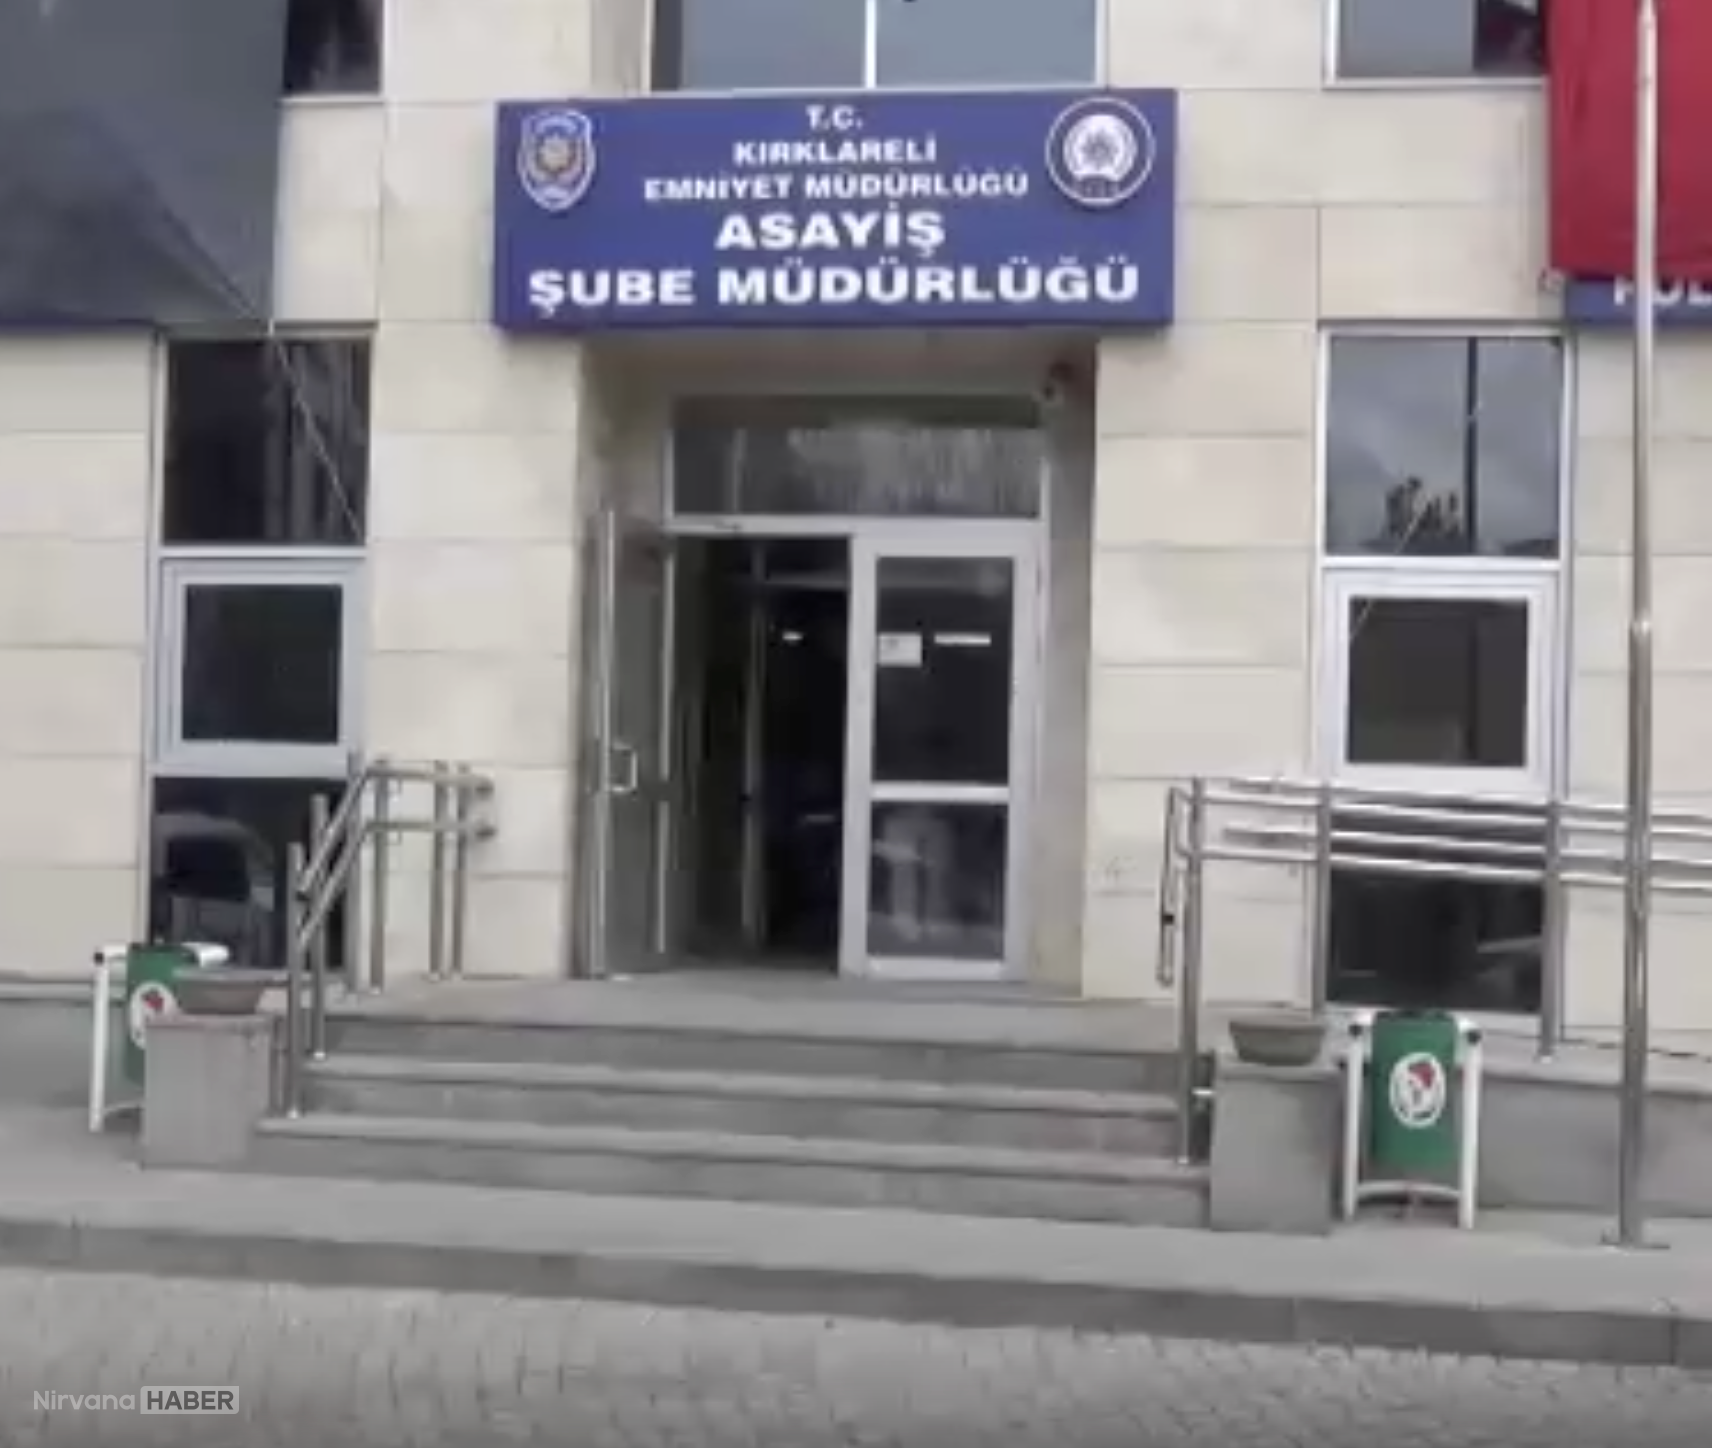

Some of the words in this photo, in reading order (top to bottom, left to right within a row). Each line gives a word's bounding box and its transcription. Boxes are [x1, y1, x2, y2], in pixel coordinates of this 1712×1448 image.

[805, 104, 863, 130] T.C.
[733, 131, 937, 166] KIRKLARELİ
[643, 171, 793, 202] EMNİYET
[804, 165, 1029, 200] MÜDÜRLÜĞÜ
[715, 202, 945, 257] ASAYİŞ
[529, 268, 695, 317] ŞUBE
[717, 256, 1139, 306] MÜDÜRLÜĞÜ
